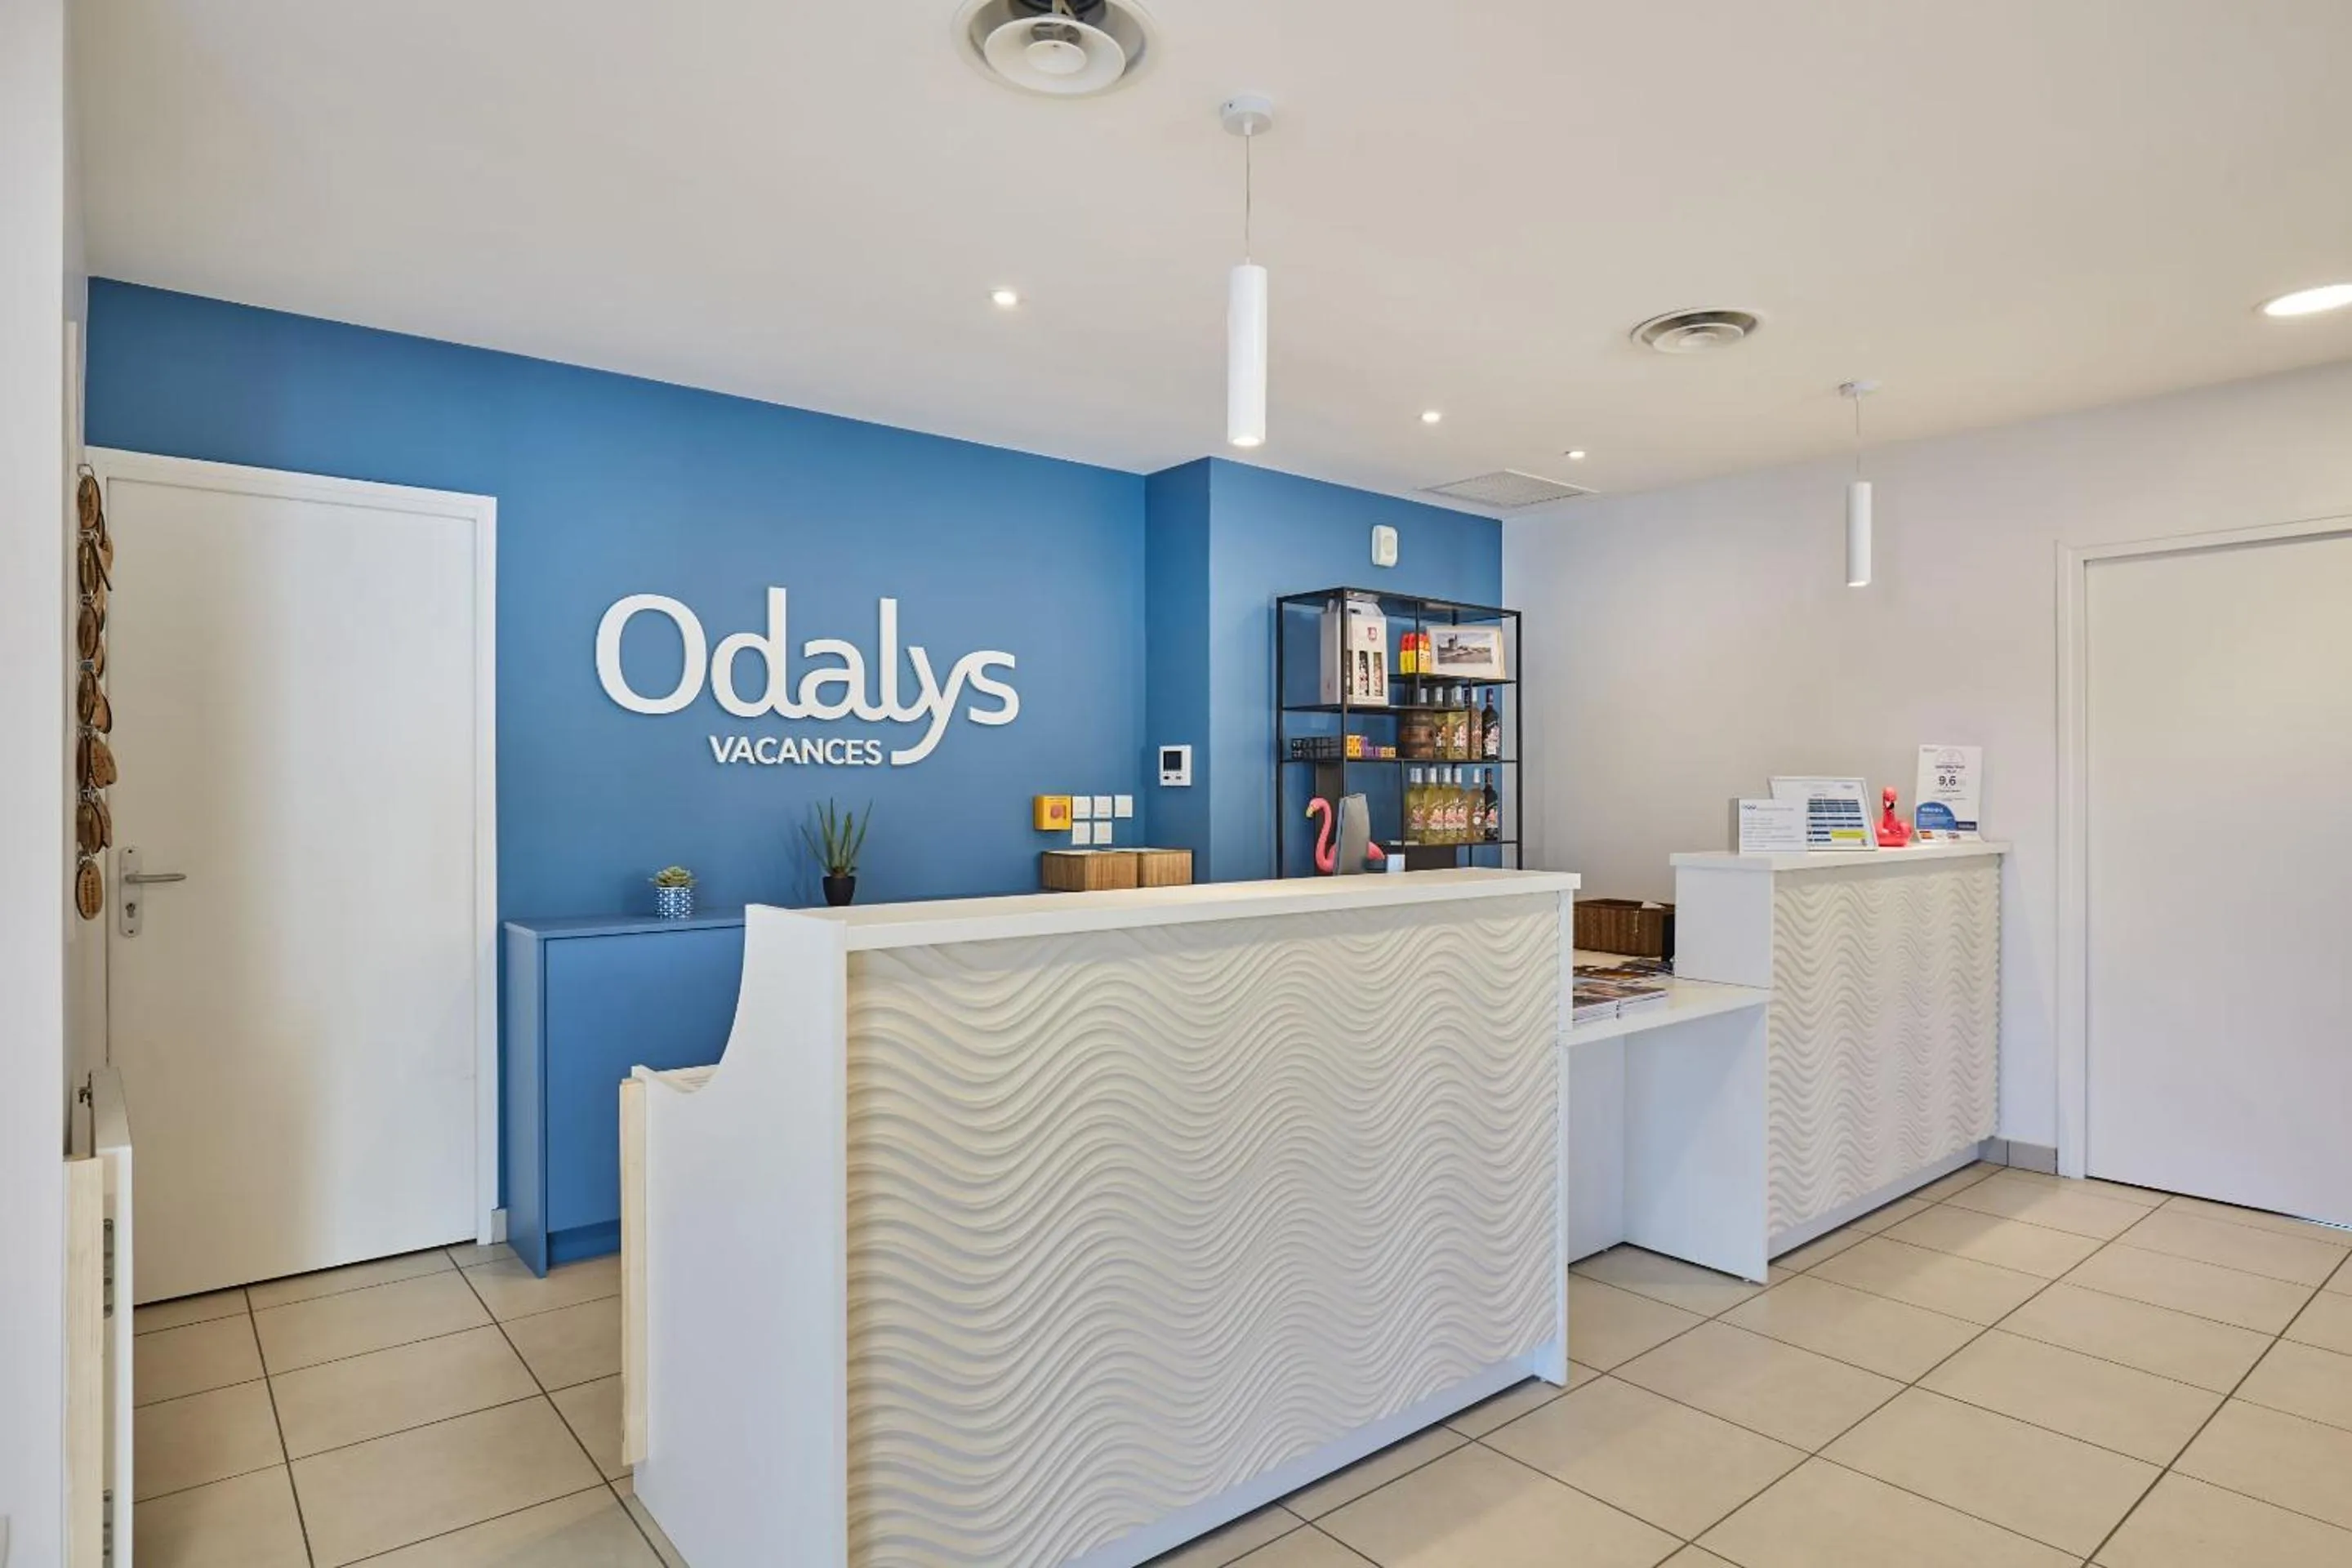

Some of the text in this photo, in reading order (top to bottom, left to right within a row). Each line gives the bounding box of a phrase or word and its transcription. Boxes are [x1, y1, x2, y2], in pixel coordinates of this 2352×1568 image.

[595, 586, 1020, 766] Odalys
[709, 735, 883, 766] VACANCES
[1939, 775, 1957, 786] 9,6
